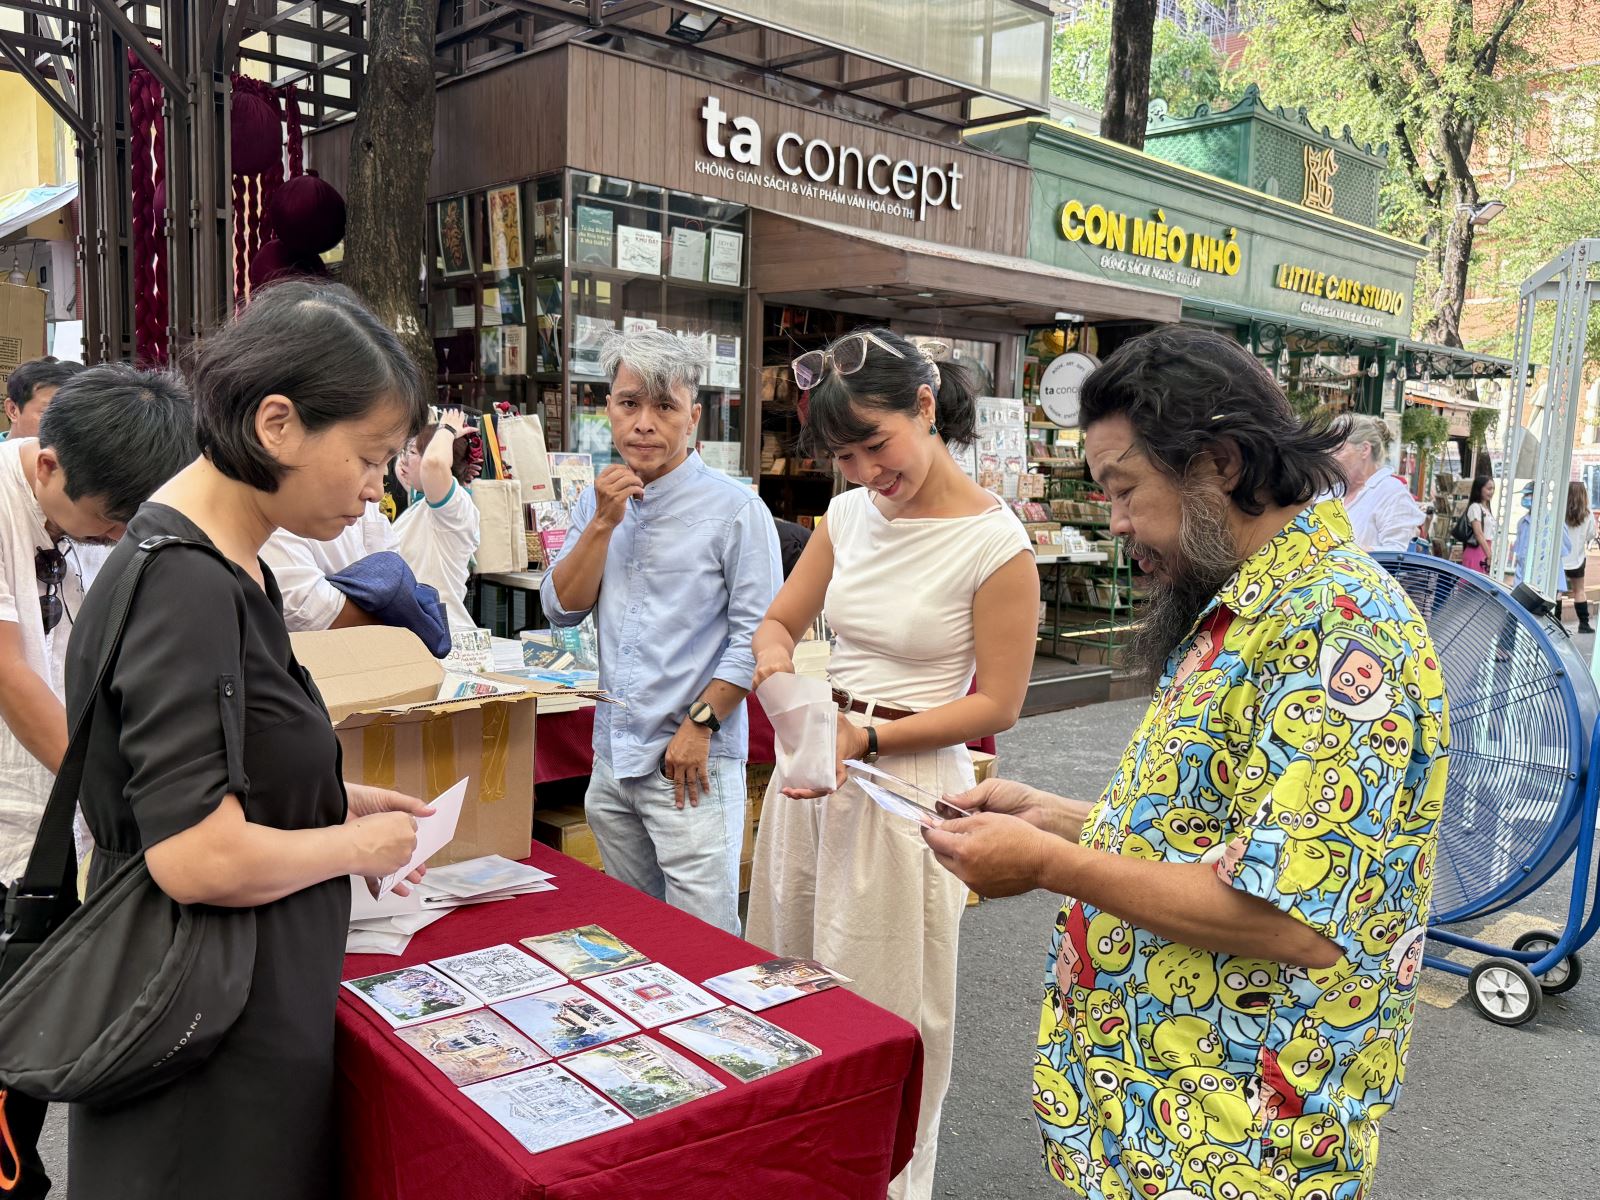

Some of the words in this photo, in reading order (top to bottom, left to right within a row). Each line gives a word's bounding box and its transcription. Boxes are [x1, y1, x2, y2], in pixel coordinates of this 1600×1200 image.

[700, 96, 762, 166] ta
[776, 131, 963, 221] concept
[695, 160, 734, 180] KHÔNG
[736, 170, 762, 186] GIAN
[763, 175, 790, 192] SÁCH
[791, 182, 798, 194] &
[799, 184, 818, 199] VẬT
[820, 188, 846, 204] PHẨM
[847, 194, 866, 208] VĂN
[866, 200, 886, 213] HOÁ
[887, 203, 901, 216] ĐÔ
[1061, 199, 1127, 252] CON
[1132, 208, 1188, 264] MÈO
[1190, 227, 1242, 276] NHỎ
[1276, 263, 1325, 297] LITTLE
[1325, 274, 1361, 305] CATS
[1361, 284, 1405, 316] STUDIO
[1045, 386, 1054, 395] ta
[1056, 386, 1081, 395] conc
[152, 1012, 202, 1067] GIORDANO
